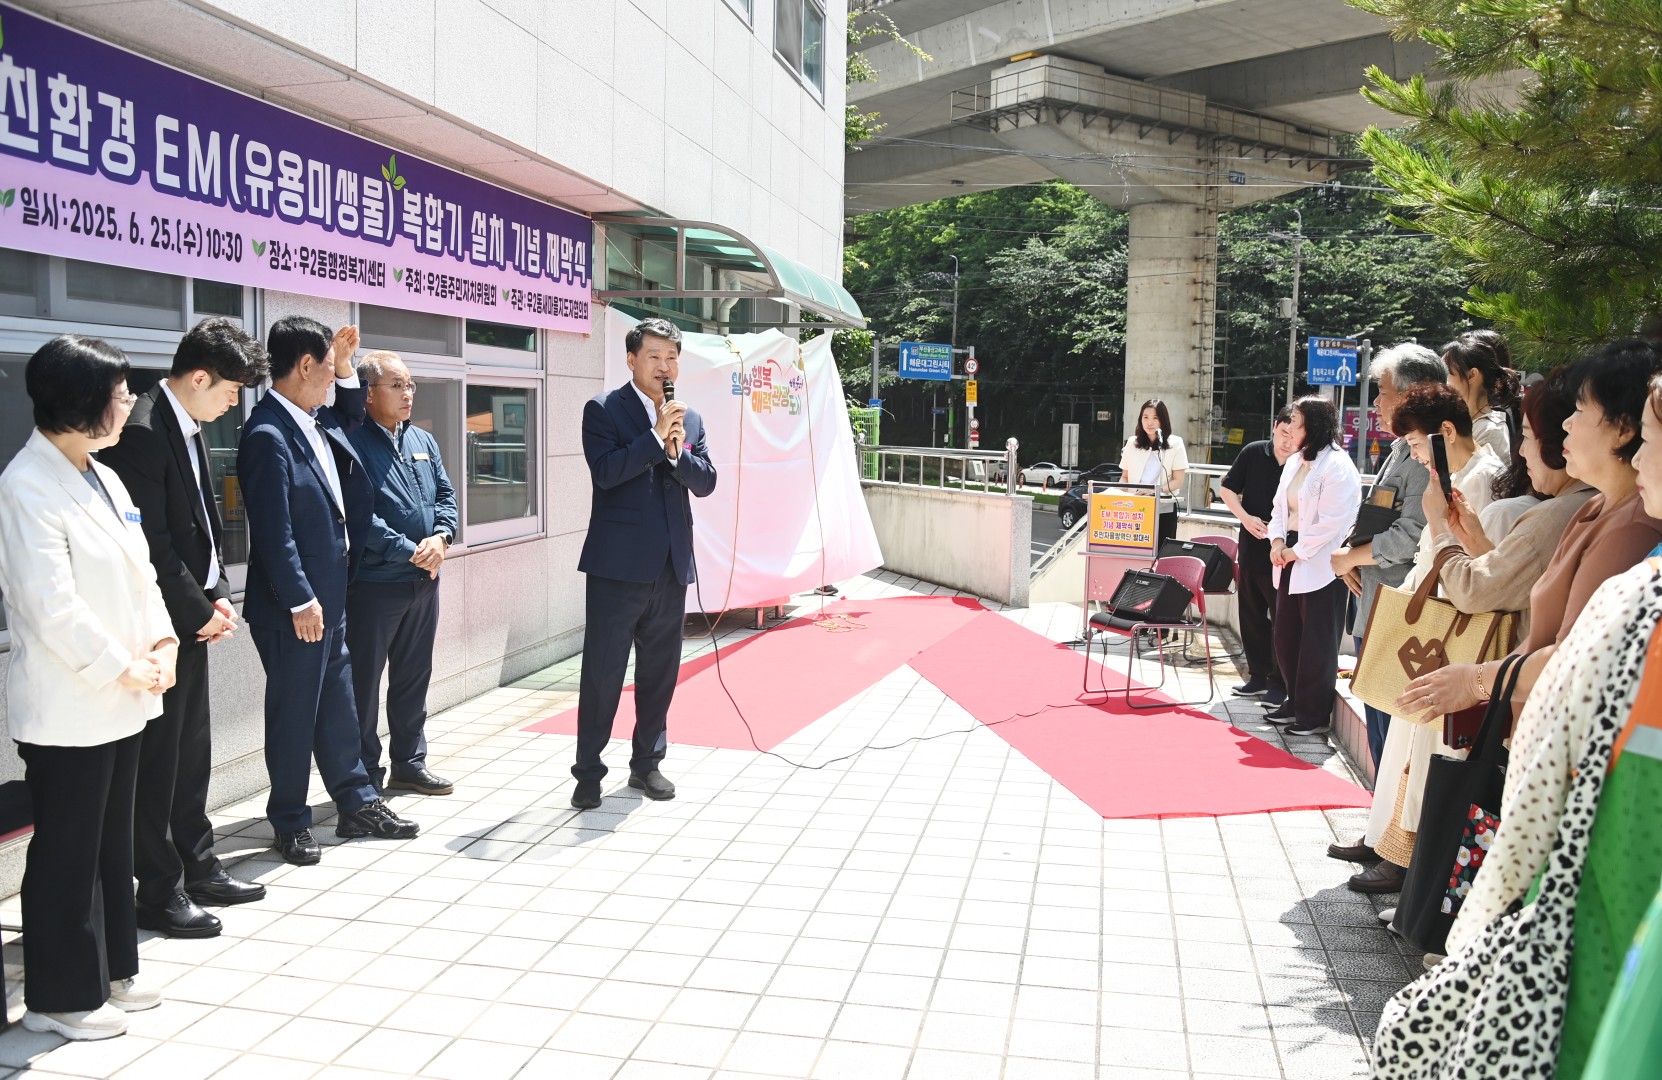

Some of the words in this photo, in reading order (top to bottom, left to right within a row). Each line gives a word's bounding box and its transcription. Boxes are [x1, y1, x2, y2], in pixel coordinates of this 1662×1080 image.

[0, 53, 135, 176] 친환경
[403, 188, 462, 256] 복합기
[471, 211, 504, 266] 설치
[511, 222, 541, 274] 기념
[546, 232, 586, 284] 제막식
[130, 211, 144, 246] 6.
[206, 227, 243, 263] 10:30
[909, 359, 949, 369] 해운대그린시티
